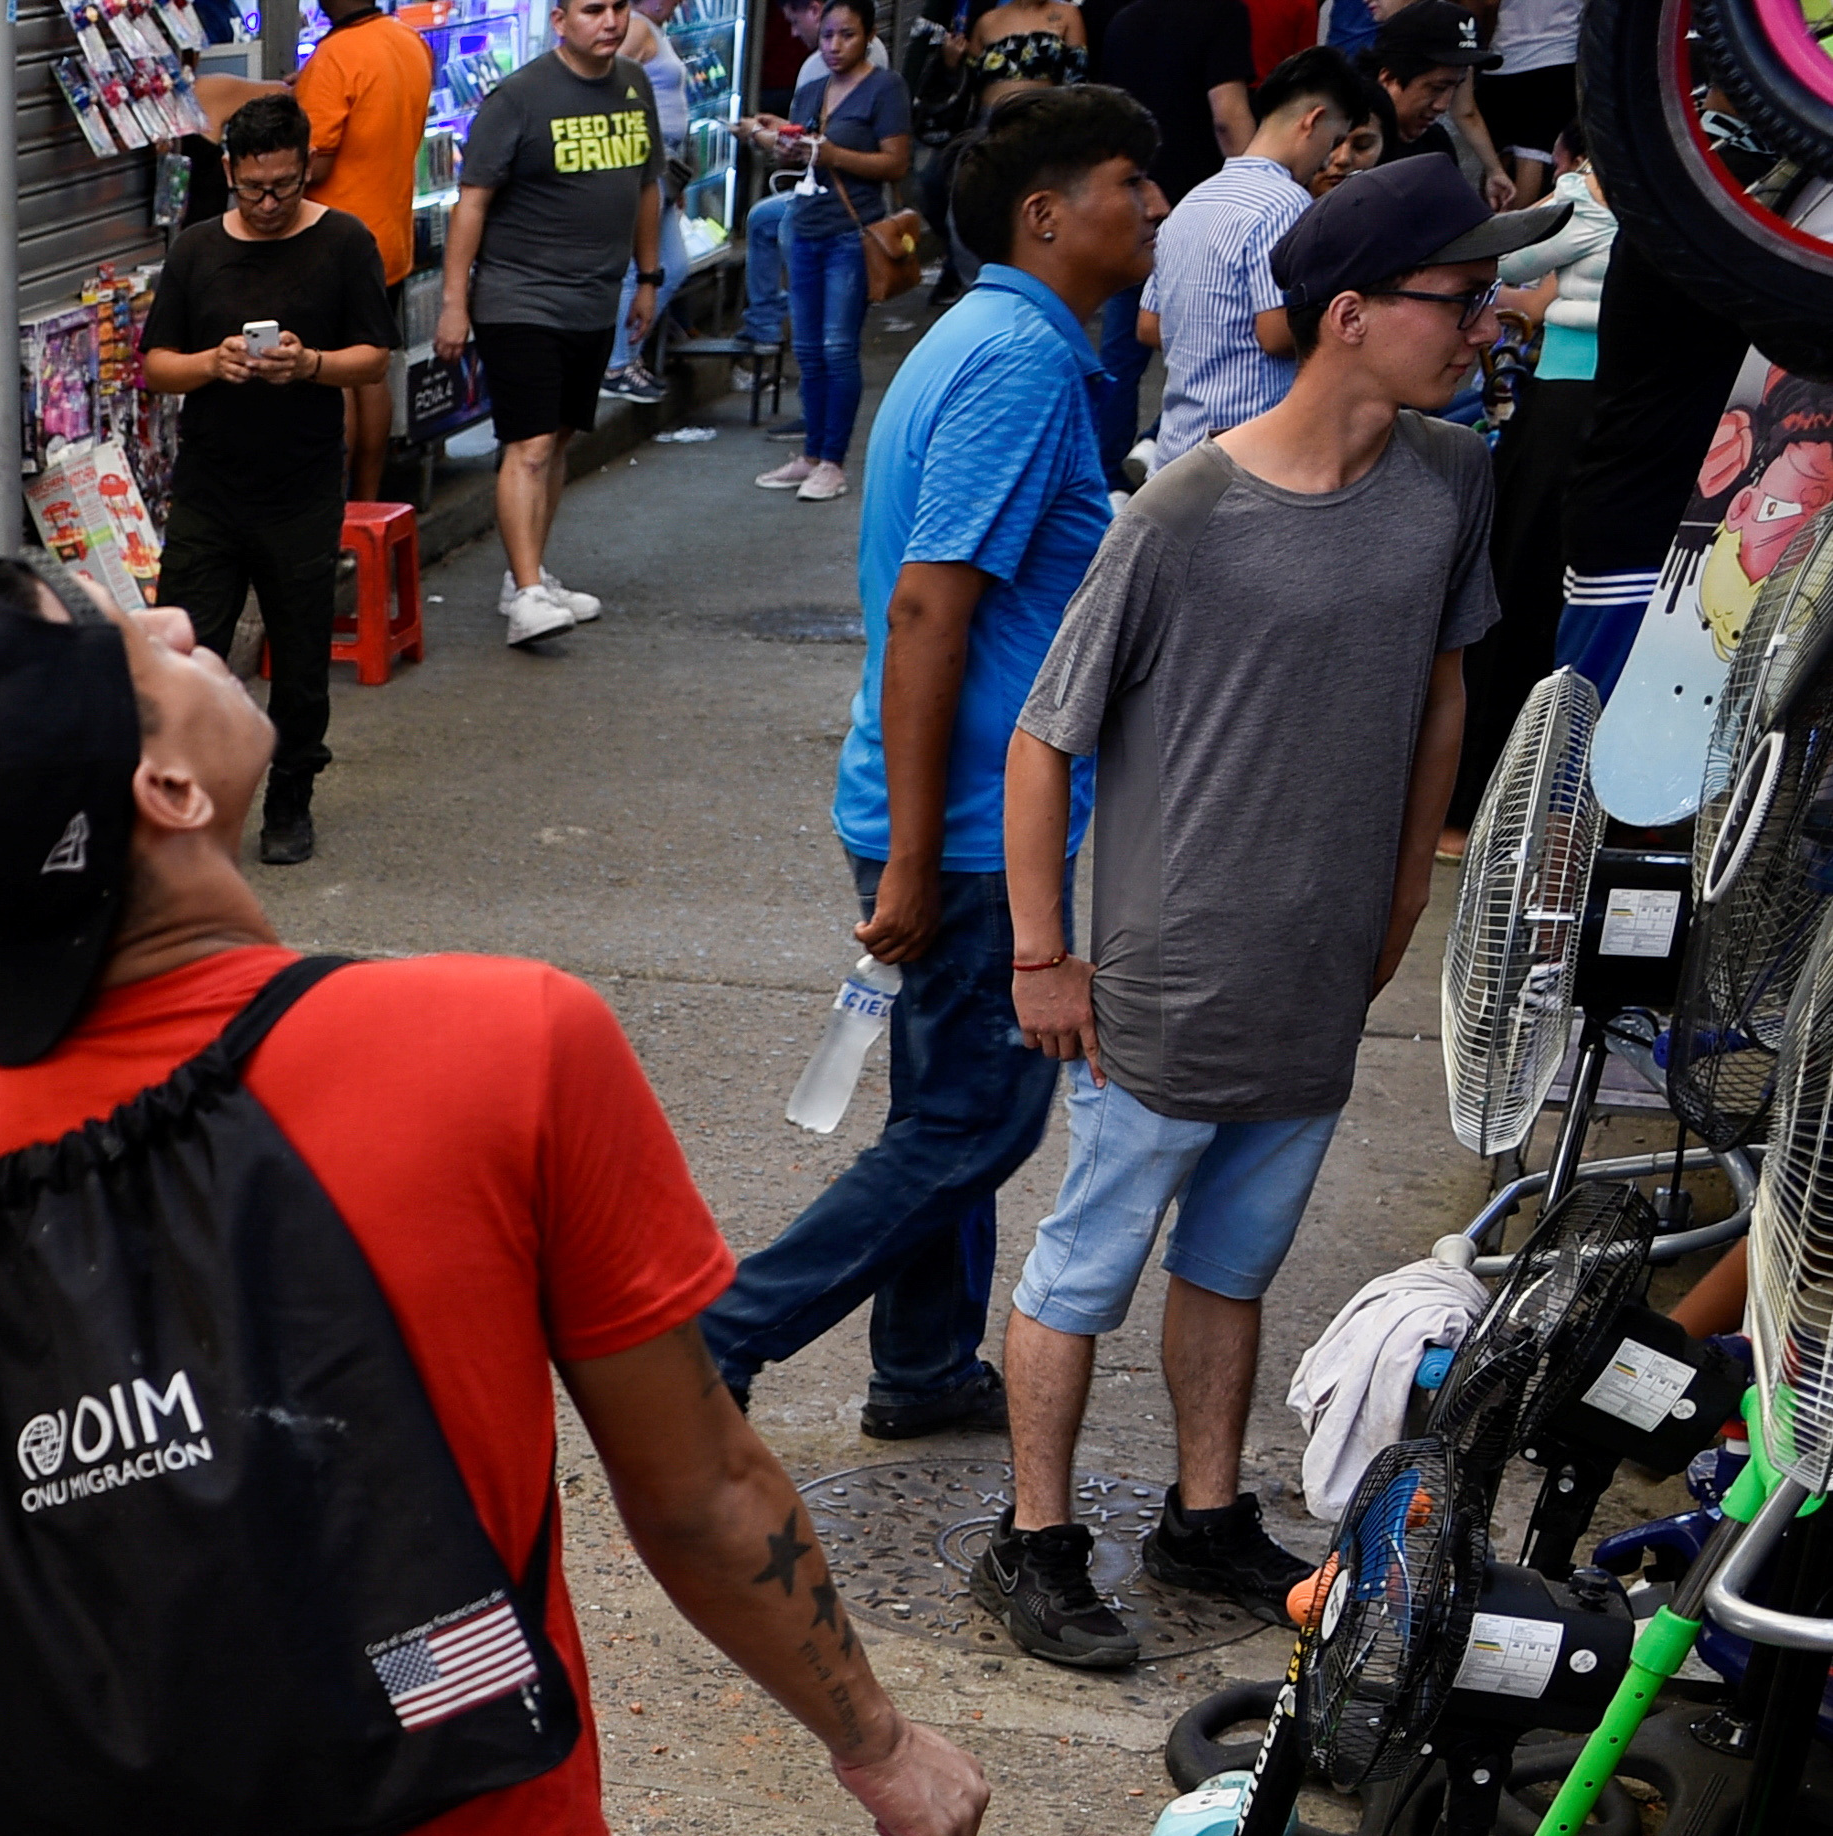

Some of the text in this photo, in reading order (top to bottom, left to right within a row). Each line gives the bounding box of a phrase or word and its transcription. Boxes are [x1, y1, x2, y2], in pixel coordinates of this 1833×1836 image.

[550, 110, 647, 142] FEED THE
[554, 133, 651, 173] GRIND
[72, 1369, 203, 1464] OIM
[21, 1436, 213, 1513] ONU MIGRACIÓN
